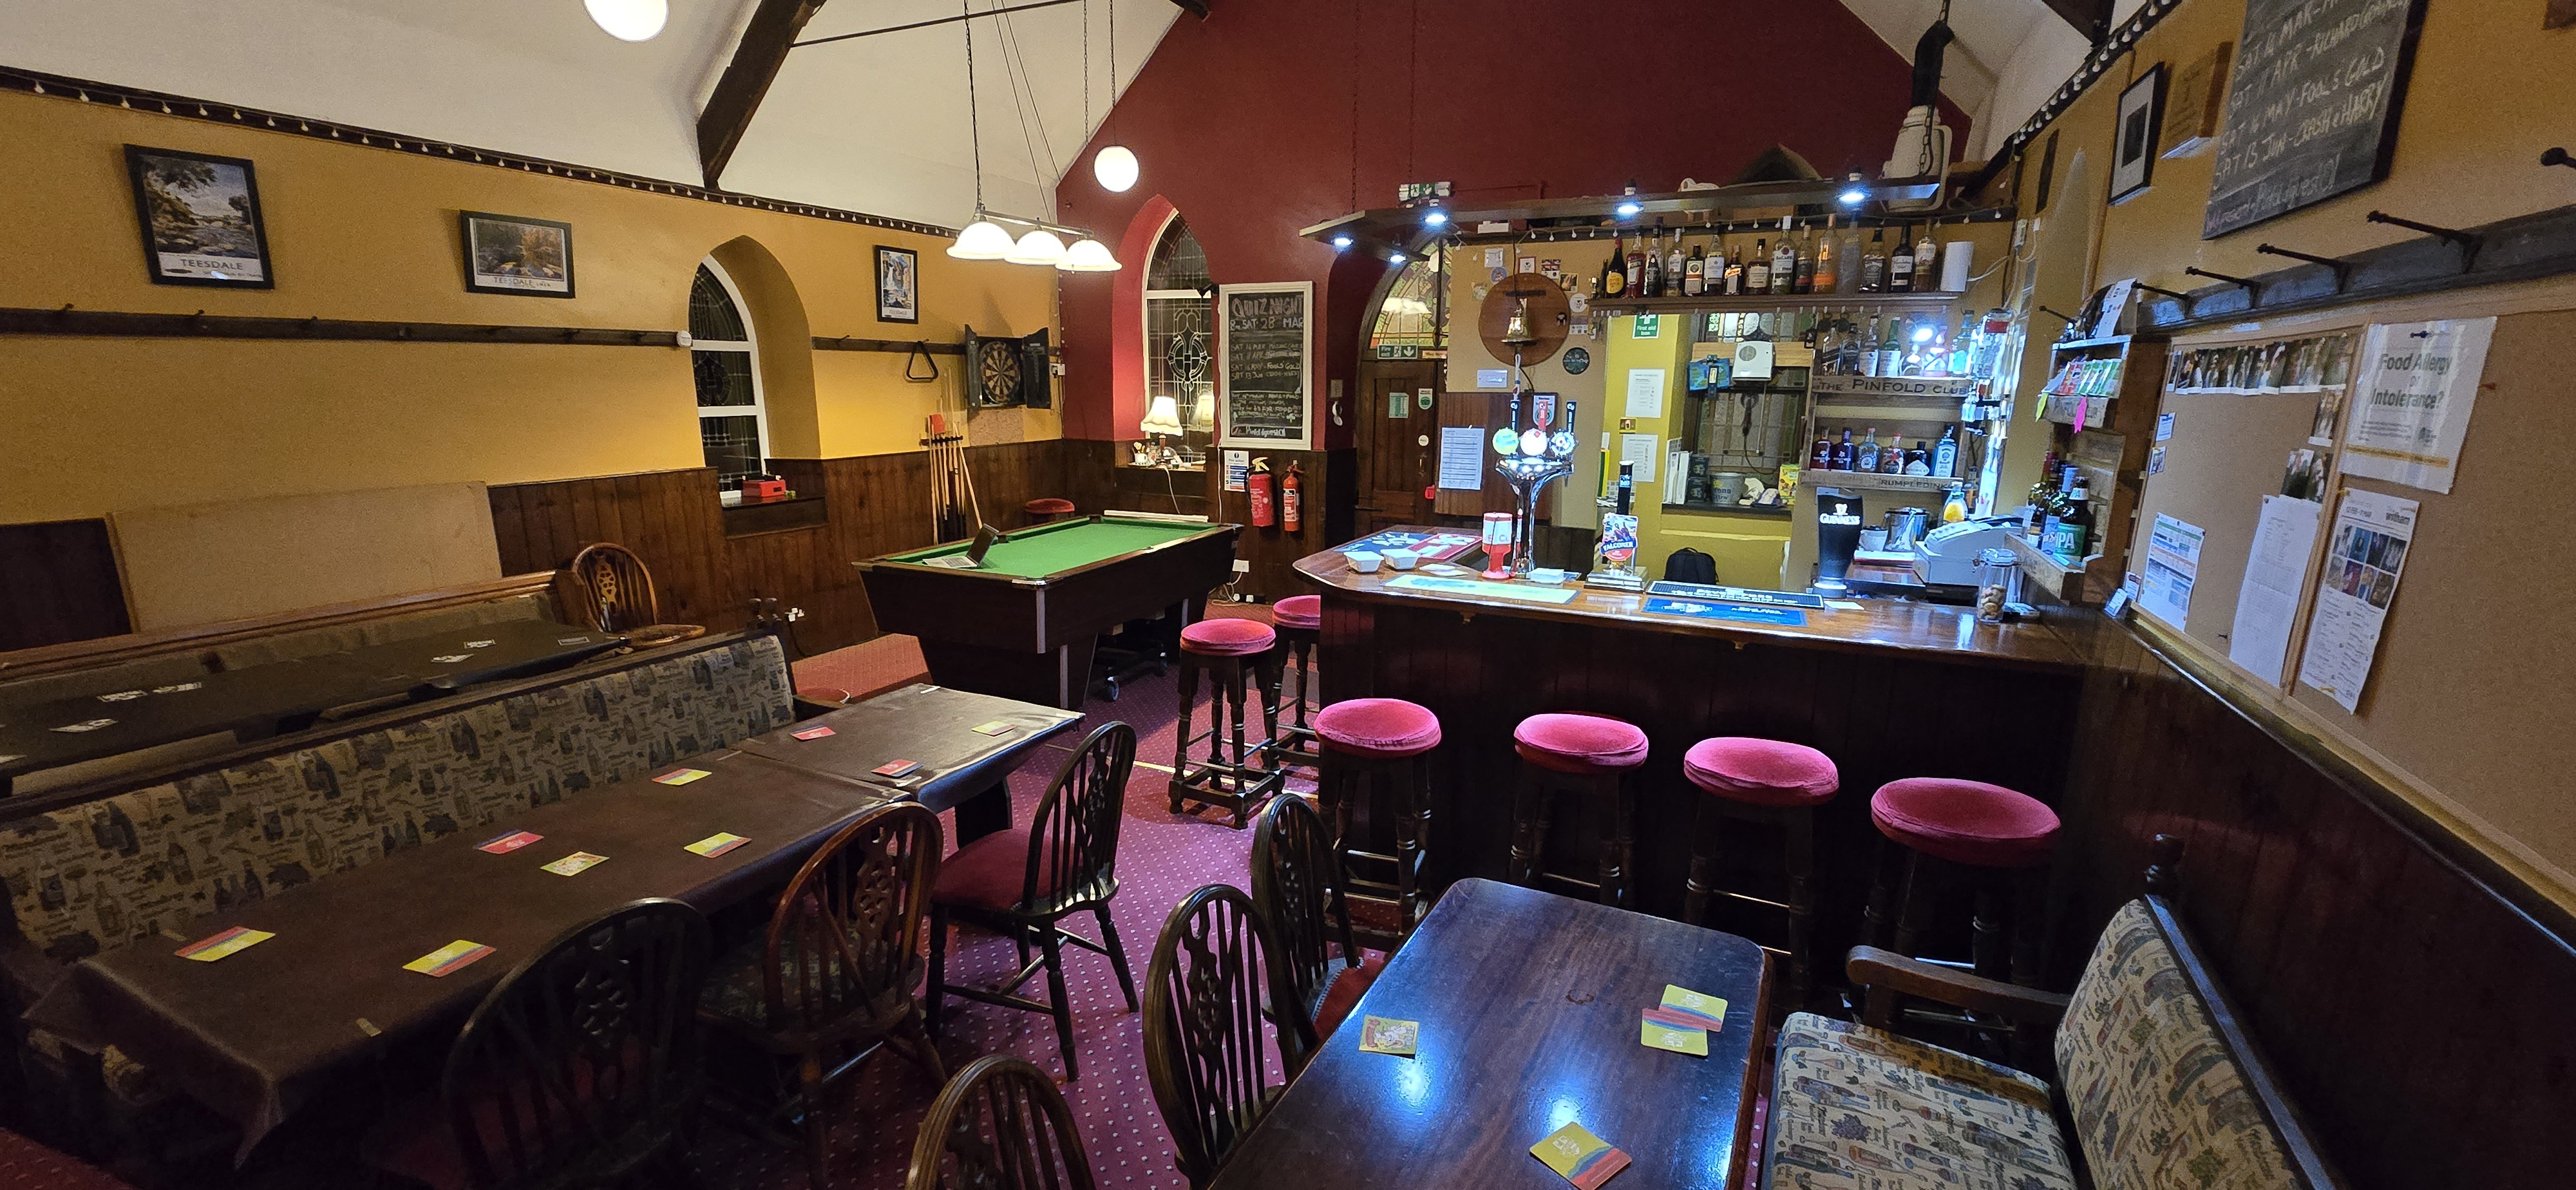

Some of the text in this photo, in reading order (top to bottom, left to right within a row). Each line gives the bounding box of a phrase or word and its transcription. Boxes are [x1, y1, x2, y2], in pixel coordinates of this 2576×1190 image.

[180, 259, 243, 270] TEESDALE
[494, 277, 533, 286] TEESDALE
[1231, 295, 1303, 317] QUIZ NIGHT
[2381, 353, 2453, 375] Food Allergy
[1820, 378, 1970, 395] THE PINFOLD CLUB
[2370, 388, 2445, 409] Intolerance?
[1820, 513, 1860, 525] GUINNESS
[2057, 533, 2075, 549] IPA
